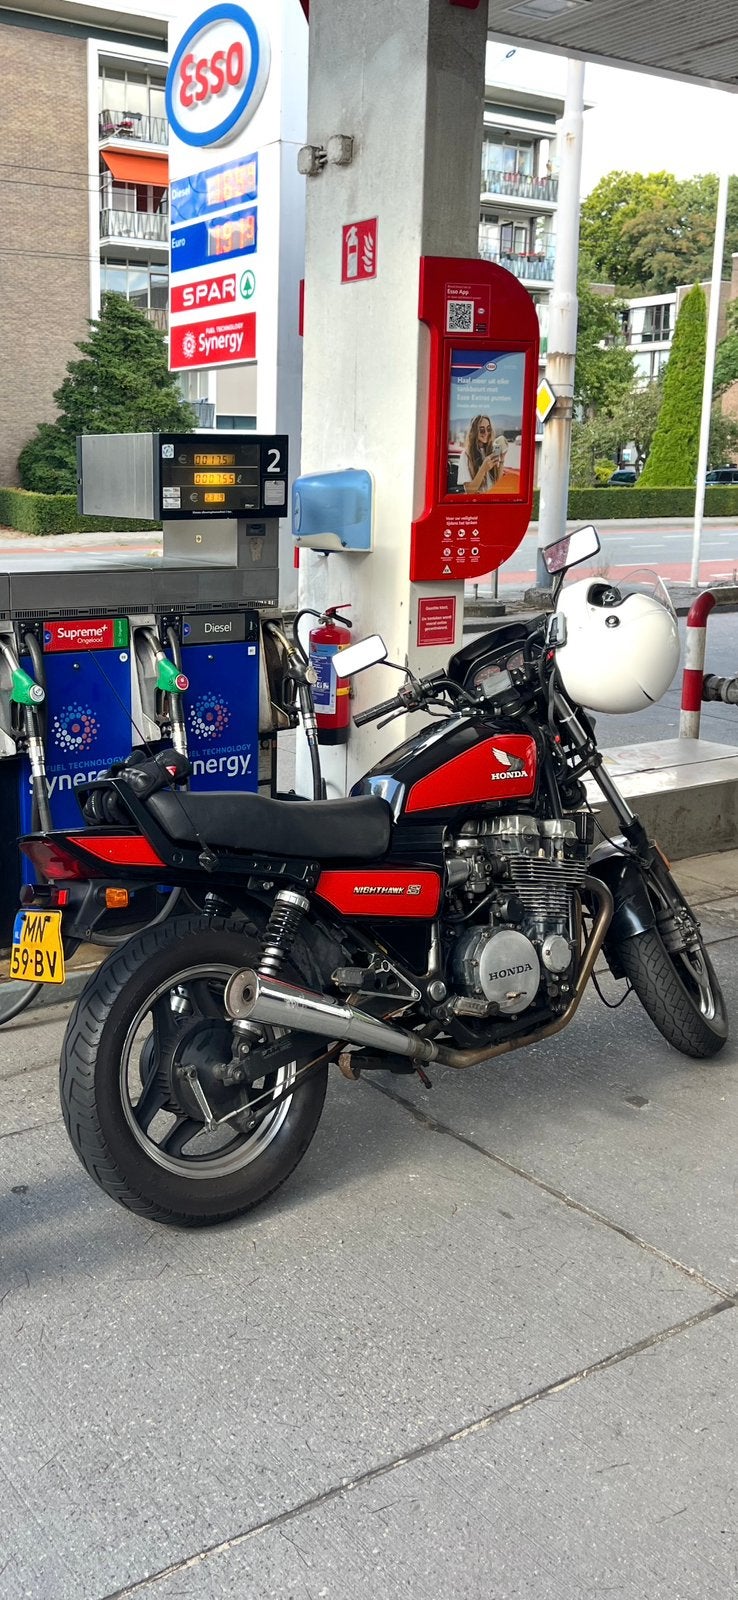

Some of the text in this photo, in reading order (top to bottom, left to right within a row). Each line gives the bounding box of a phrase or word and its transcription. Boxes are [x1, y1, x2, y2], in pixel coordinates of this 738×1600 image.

[180, 42, 244, 107] Esso
[171, 183, 191, 200] Diesel
[171, 238, 186, 249] Euro
[182, 278, 236, 307] SPAR
[215, 322, 244, 333] TECHNOLOGY
[198, 332, 244, 356] Synergy
[266, 448, 281, 473] 2
[204, 622, 232, 633] Diesel
[202, 743, 252, 756] TECHNOLOGY
[68, 756, 124, 769] TECHNOLOGY
[491, 770, 528, 780] HONDA
[353, 886, 405, 894] NIGHTHAWK
[23, 915, 47, 943] MN
[489, 963, 533, 981] HONDA
